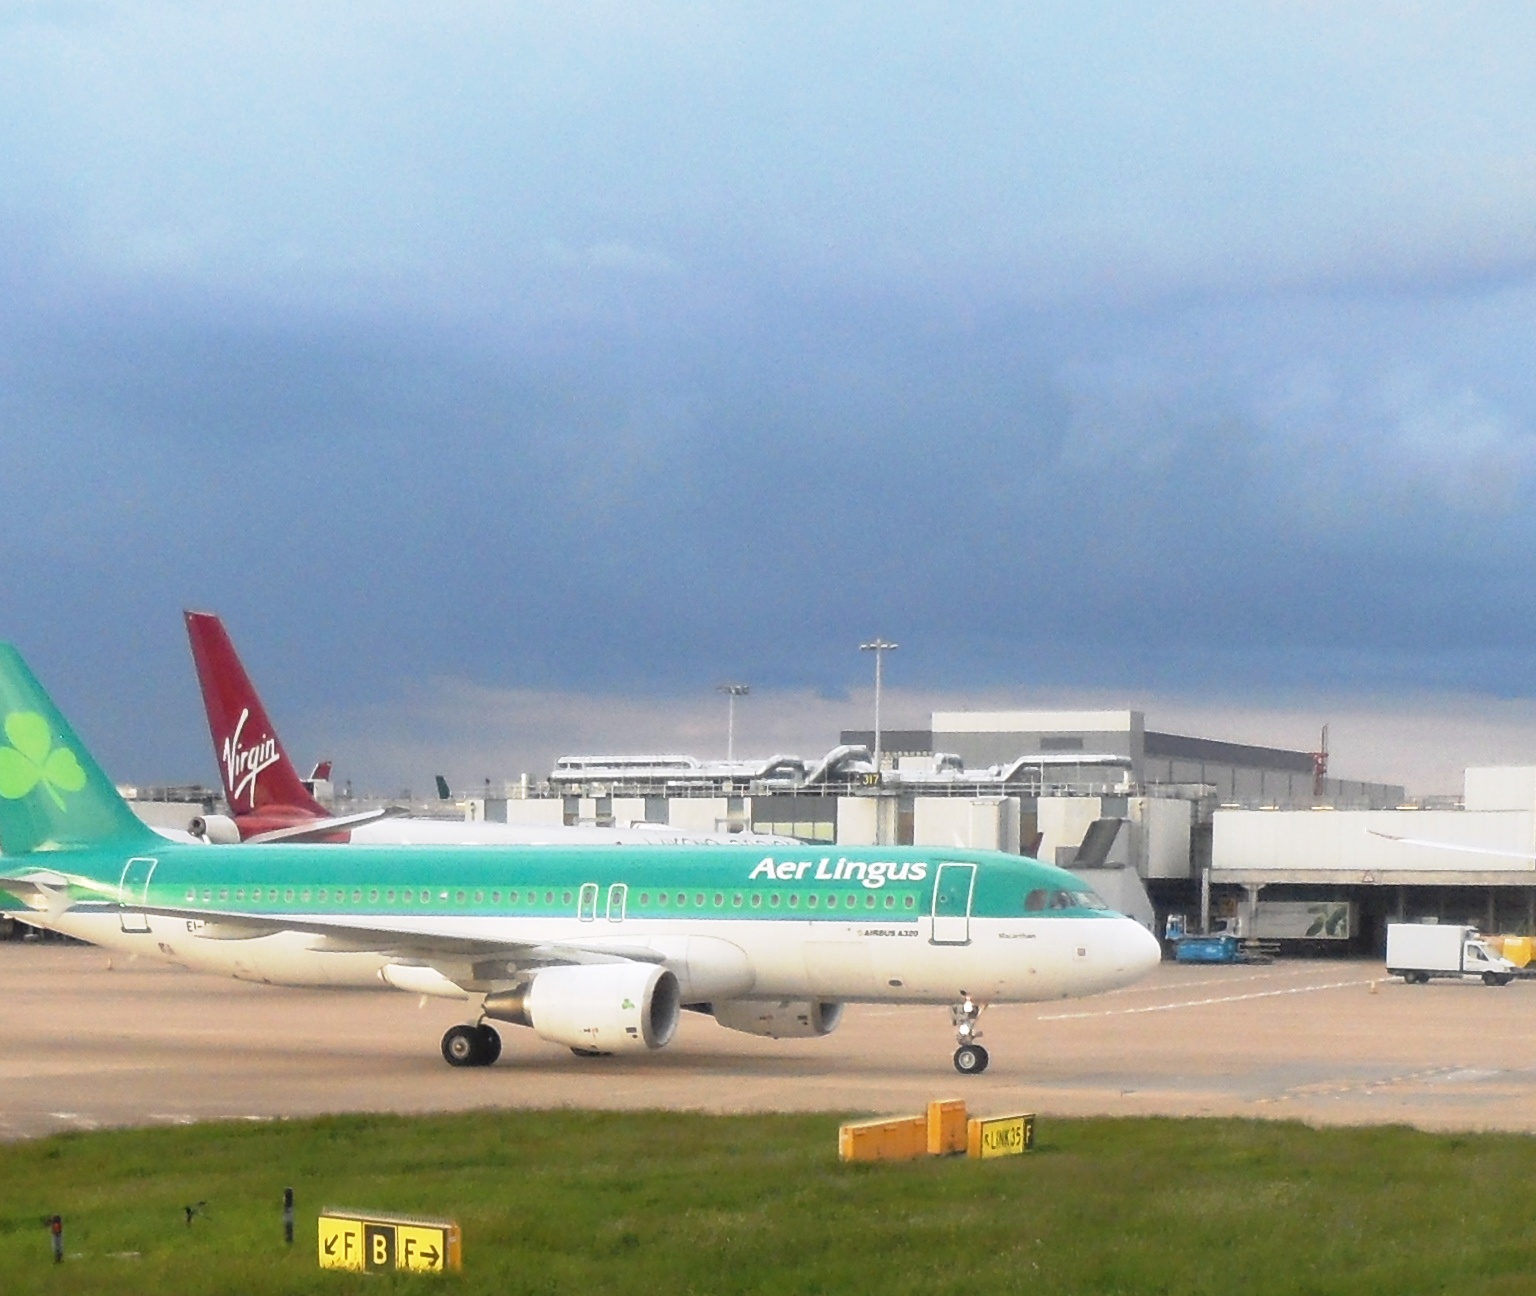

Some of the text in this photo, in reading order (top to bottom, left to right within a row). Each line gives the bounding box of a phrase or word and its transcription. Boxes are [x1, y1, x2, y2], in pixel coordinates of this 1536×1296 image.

[222, 707, 280, 809] Virgin
[862, 773, 880, 786] 317
[749, 857, 928, 889] Aer Lingus
[864, 929, 896, 937] AIRBUS
[1025, 1124, 1032, 1144] F
[344, 1231, 417, 1267] F B F
